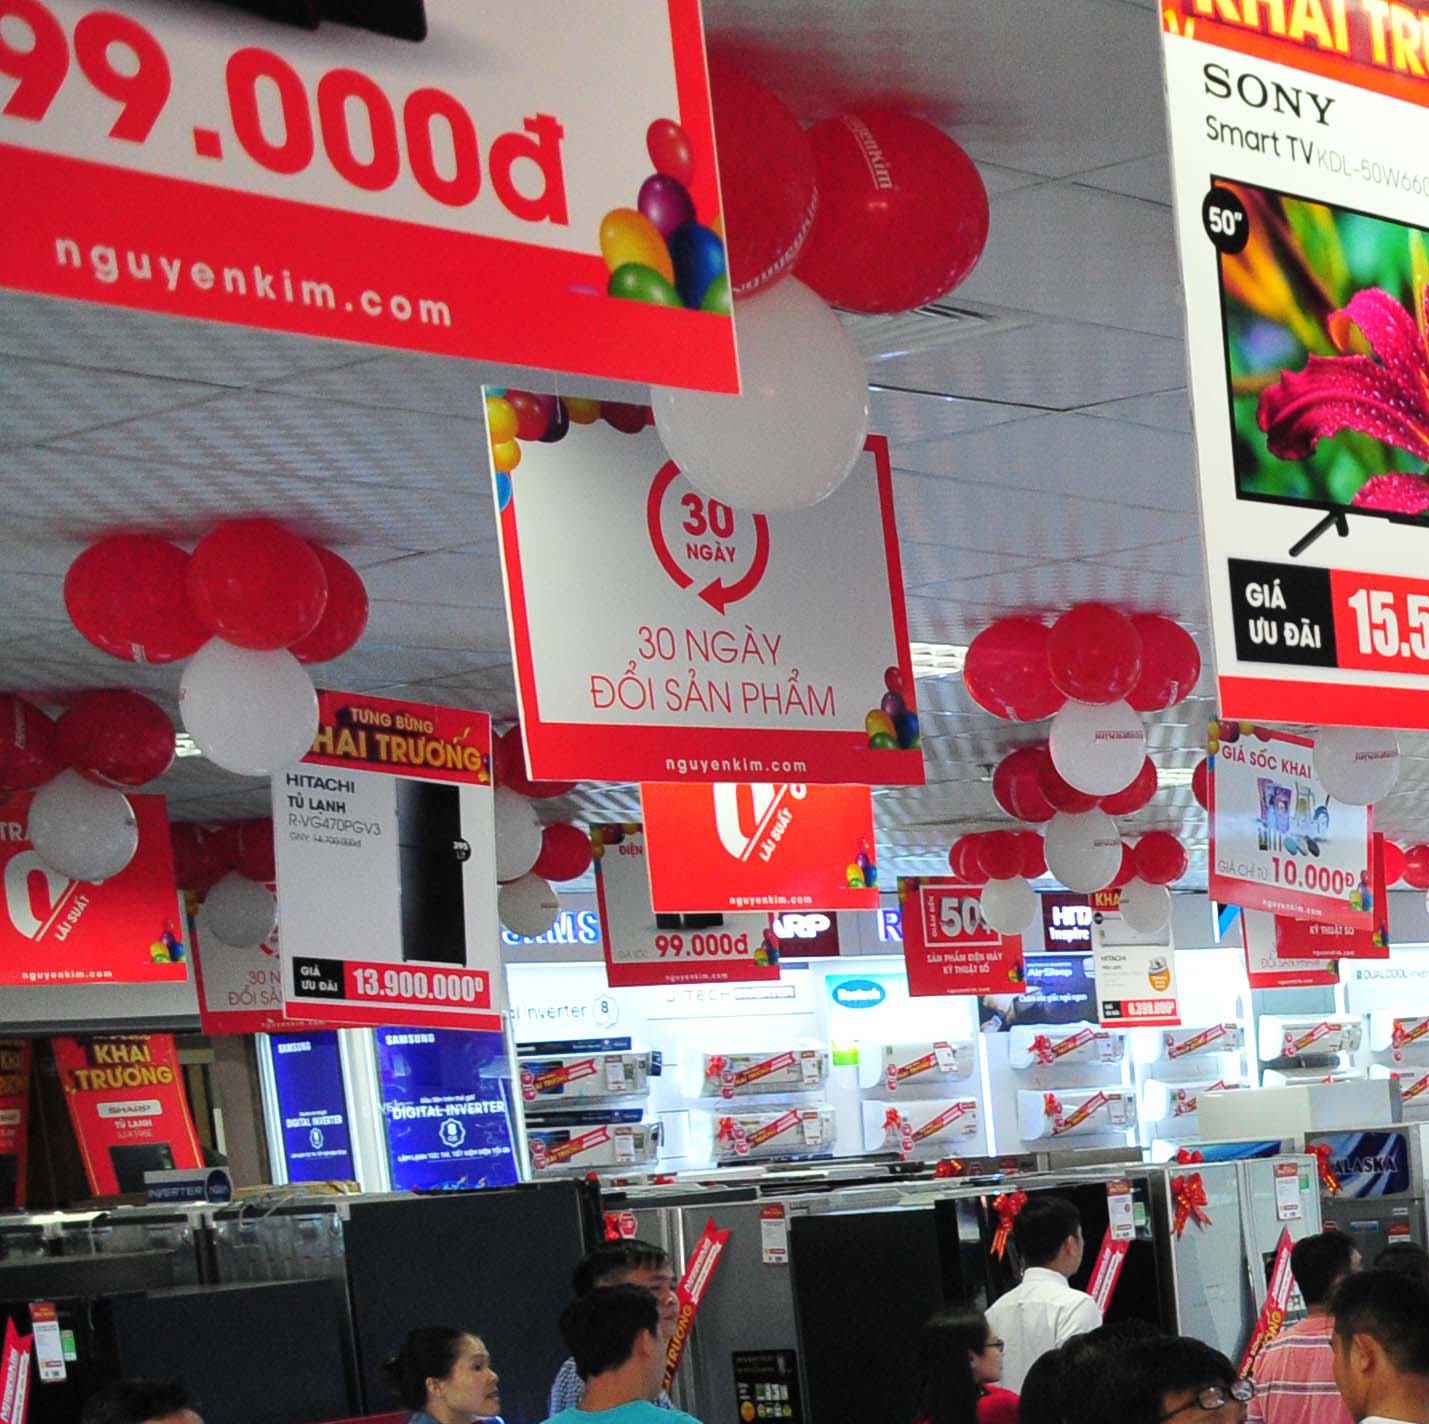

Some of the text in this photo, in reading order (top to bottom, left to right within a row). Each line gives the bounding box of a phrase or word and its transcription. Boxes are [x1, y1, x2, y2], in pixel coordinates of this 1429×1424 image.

[1203, 63, 1336, 126] SONY
[1205, 115, 1281, 158] Smart
[1287, 135, 1313, 165] TV
[55, 234, 452, 328] nguyenkim.com
[680, 493, 735, 539] 30
[686, 540, 737, 563] NGÀY
[1245, 579, 1286, 611] GIÁ
[638, 625, 782, 666] 30 NGÀY
[1248, 615, 1322, 650] ƯU ĐÃI
[590, 661, 836, 717] ĐỔI SẢN PHẨM
[351, 706, 435, 736] TƯNG BỪNG
[312, 725, 482, 772] HAI TRƯƠNG
[1221, 744, 1312, 777] GIÁ SỐC KHAI
[665, 756, 807, 775] nguyenkim.com
[286, 773, 355, 794] HITACHI
[287, 794, 346, 815] TỦ LẠNH
[770, 807, 793, 840] SUẤT
[1272, 856, 1355, 894] 10.000Đ
[67, 895, 90, 924] SUẤT
[729, 894, 812, 905] nguyenkim.com
[655, 934, 749, 957] 99.000đ
[22, 970, 113, 981] nguyenkim.com
[300, 963, 321, 978] GIÁ
[301, 978, 339, 994] ƯU ĐÃI
[352, 968, 484, 1003] 13.900.000Đ
[385, 1033, 436, 1046] SAMSUNG
[94, 1044, 151, 1065] KHAI
[73, 1065, 174, 1090] TRƯƠNG
[392, 1101, 505, 1120] DIGITAL INVERTER
